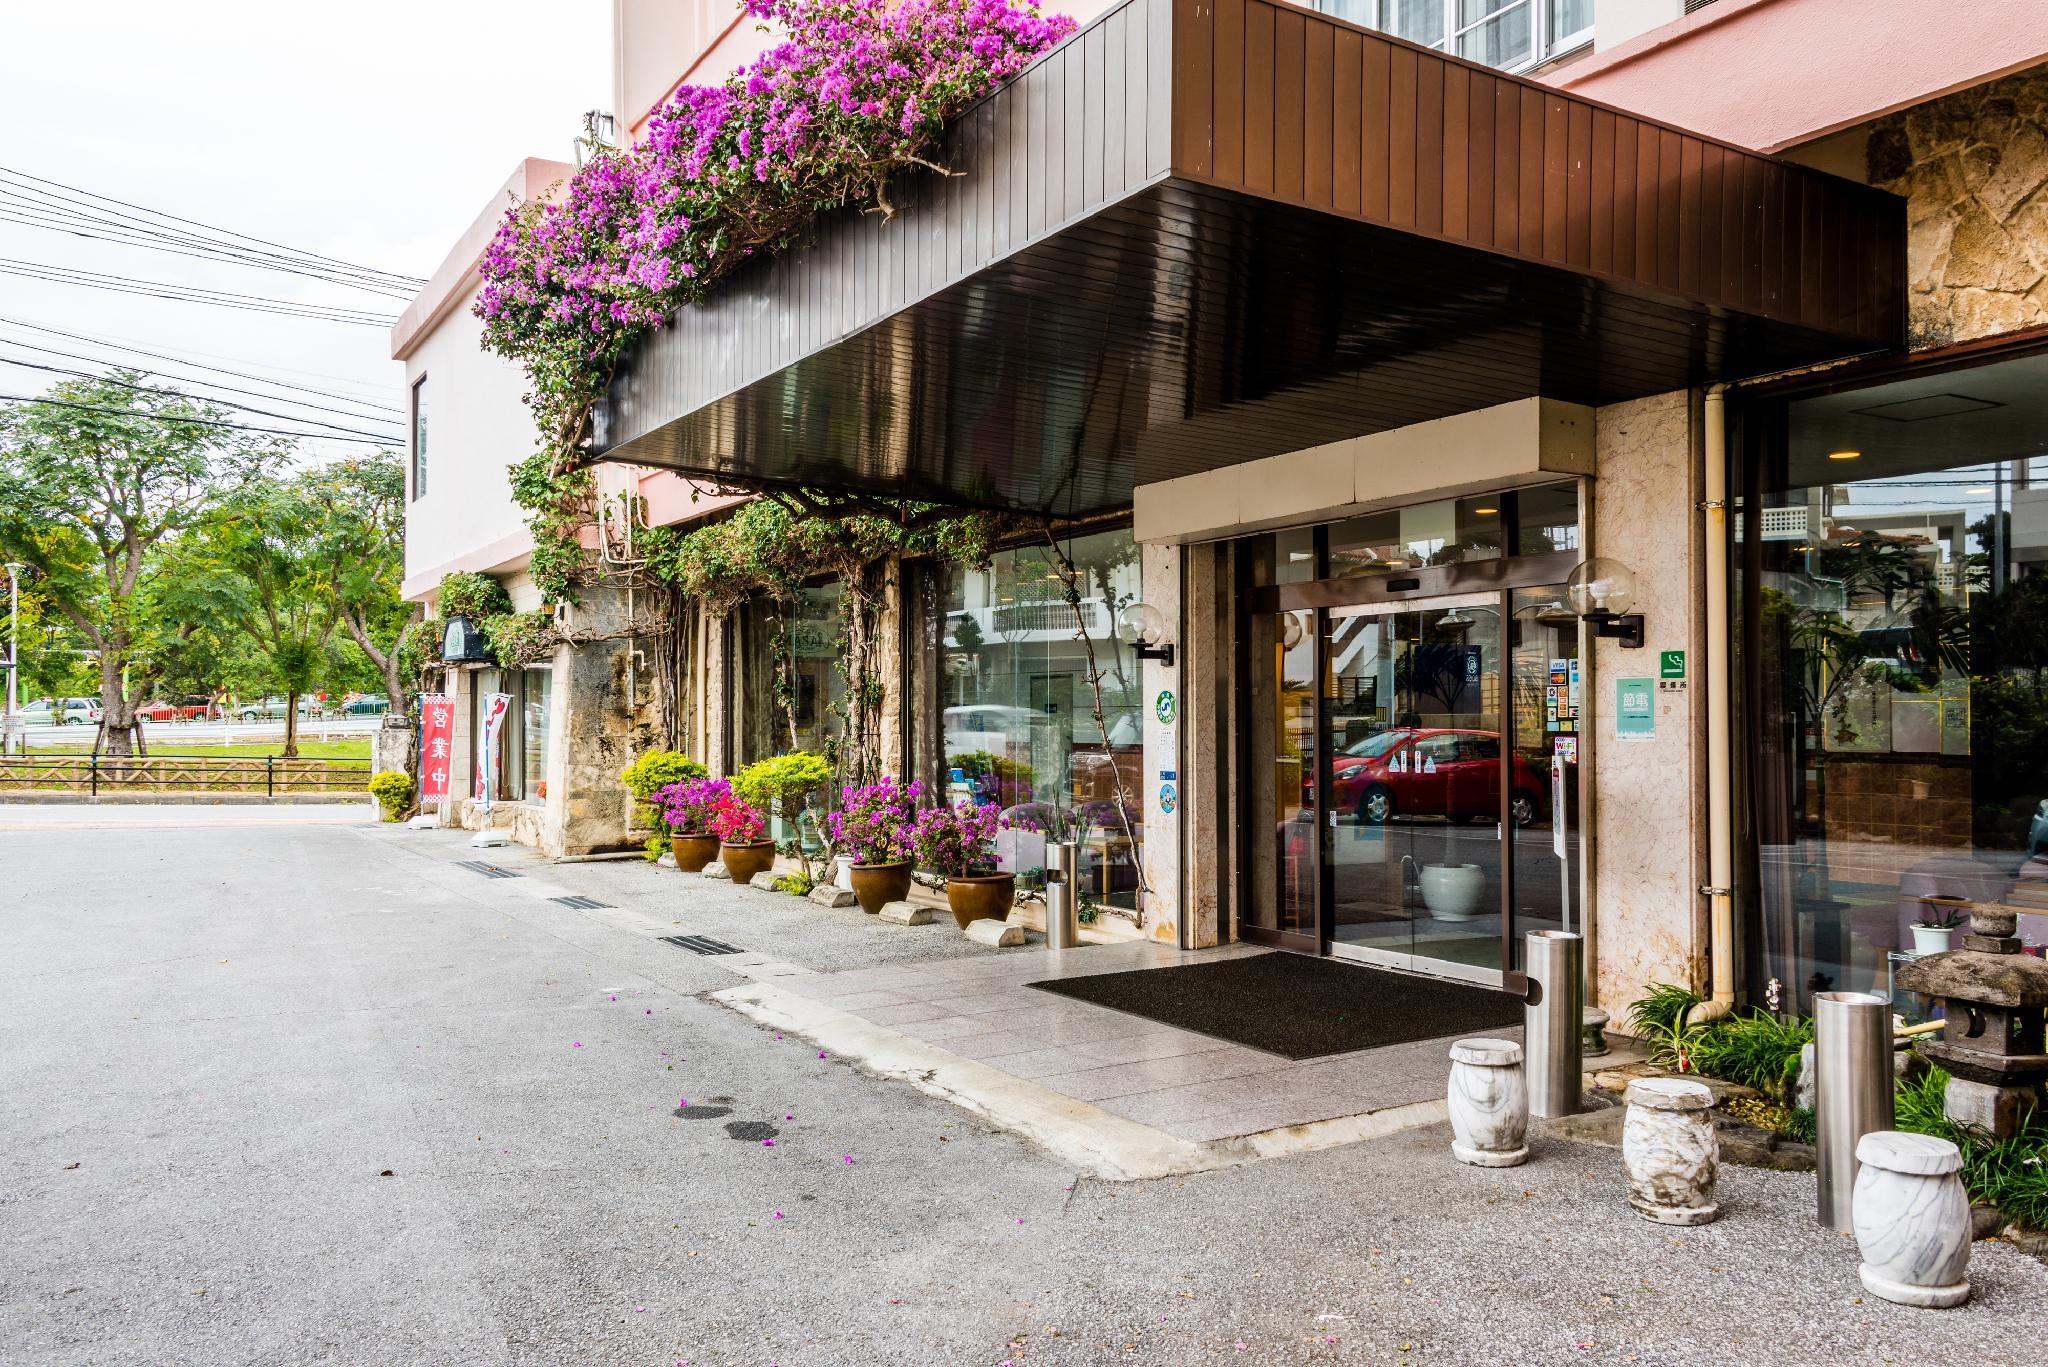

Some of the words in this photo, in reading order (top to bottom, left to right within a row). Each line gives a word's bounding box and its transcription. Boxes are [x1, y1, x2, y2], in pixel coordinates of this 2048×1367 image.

[1623, 692, 1648, 707] 節電
[430, 705, 449, 792] 営業中
